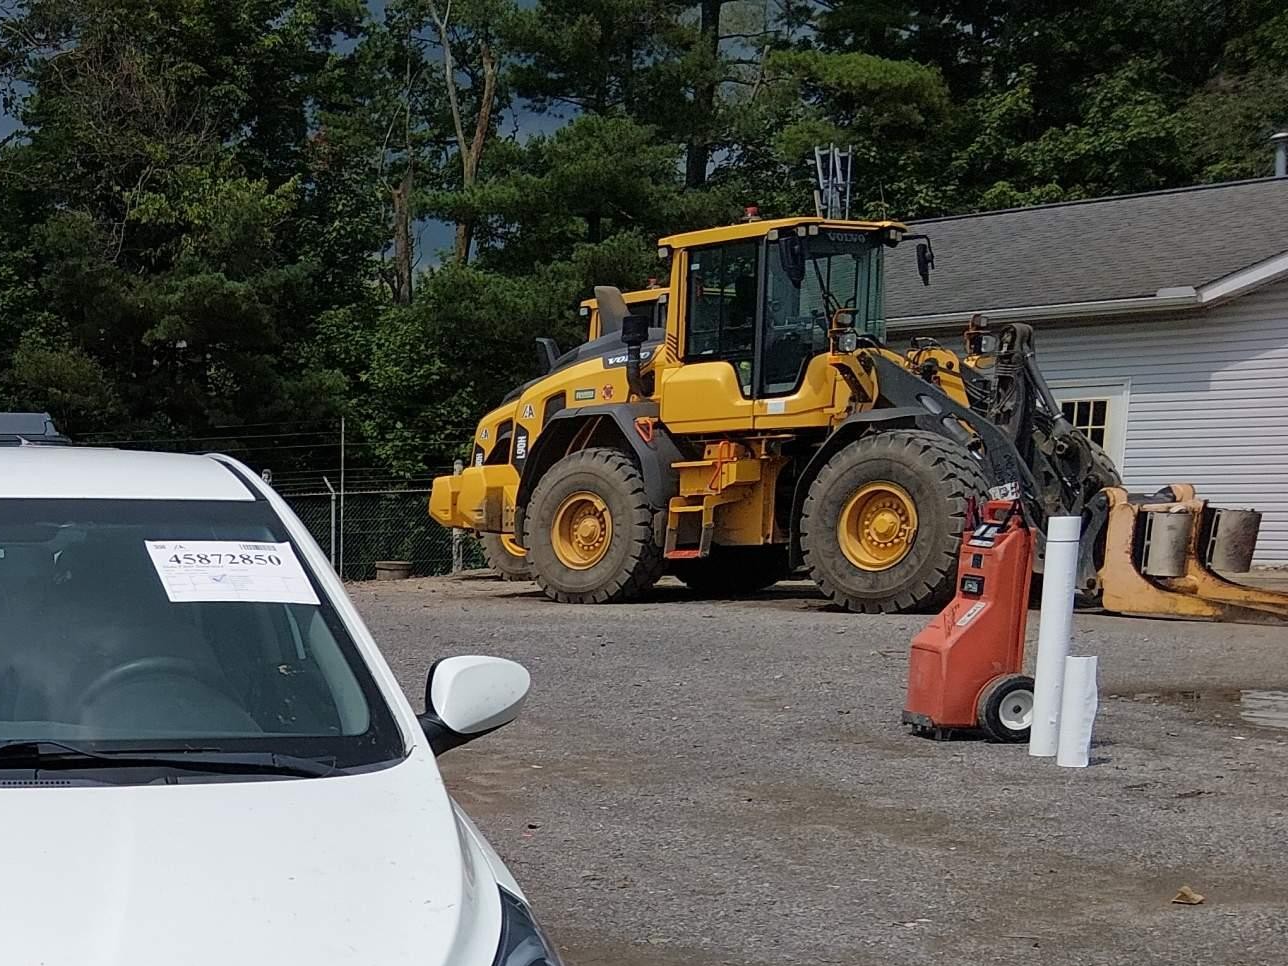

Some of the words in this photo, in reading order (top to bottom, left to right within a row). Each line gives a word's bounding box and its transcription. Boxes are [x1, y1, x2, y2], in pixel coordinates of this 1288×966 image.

[827, 232, 866, 243] VOLVO
[608, 351, 651, 365] VOLO
[516, 435, 527, 459] L90H
[168, 553, 282, 566] 45872850
